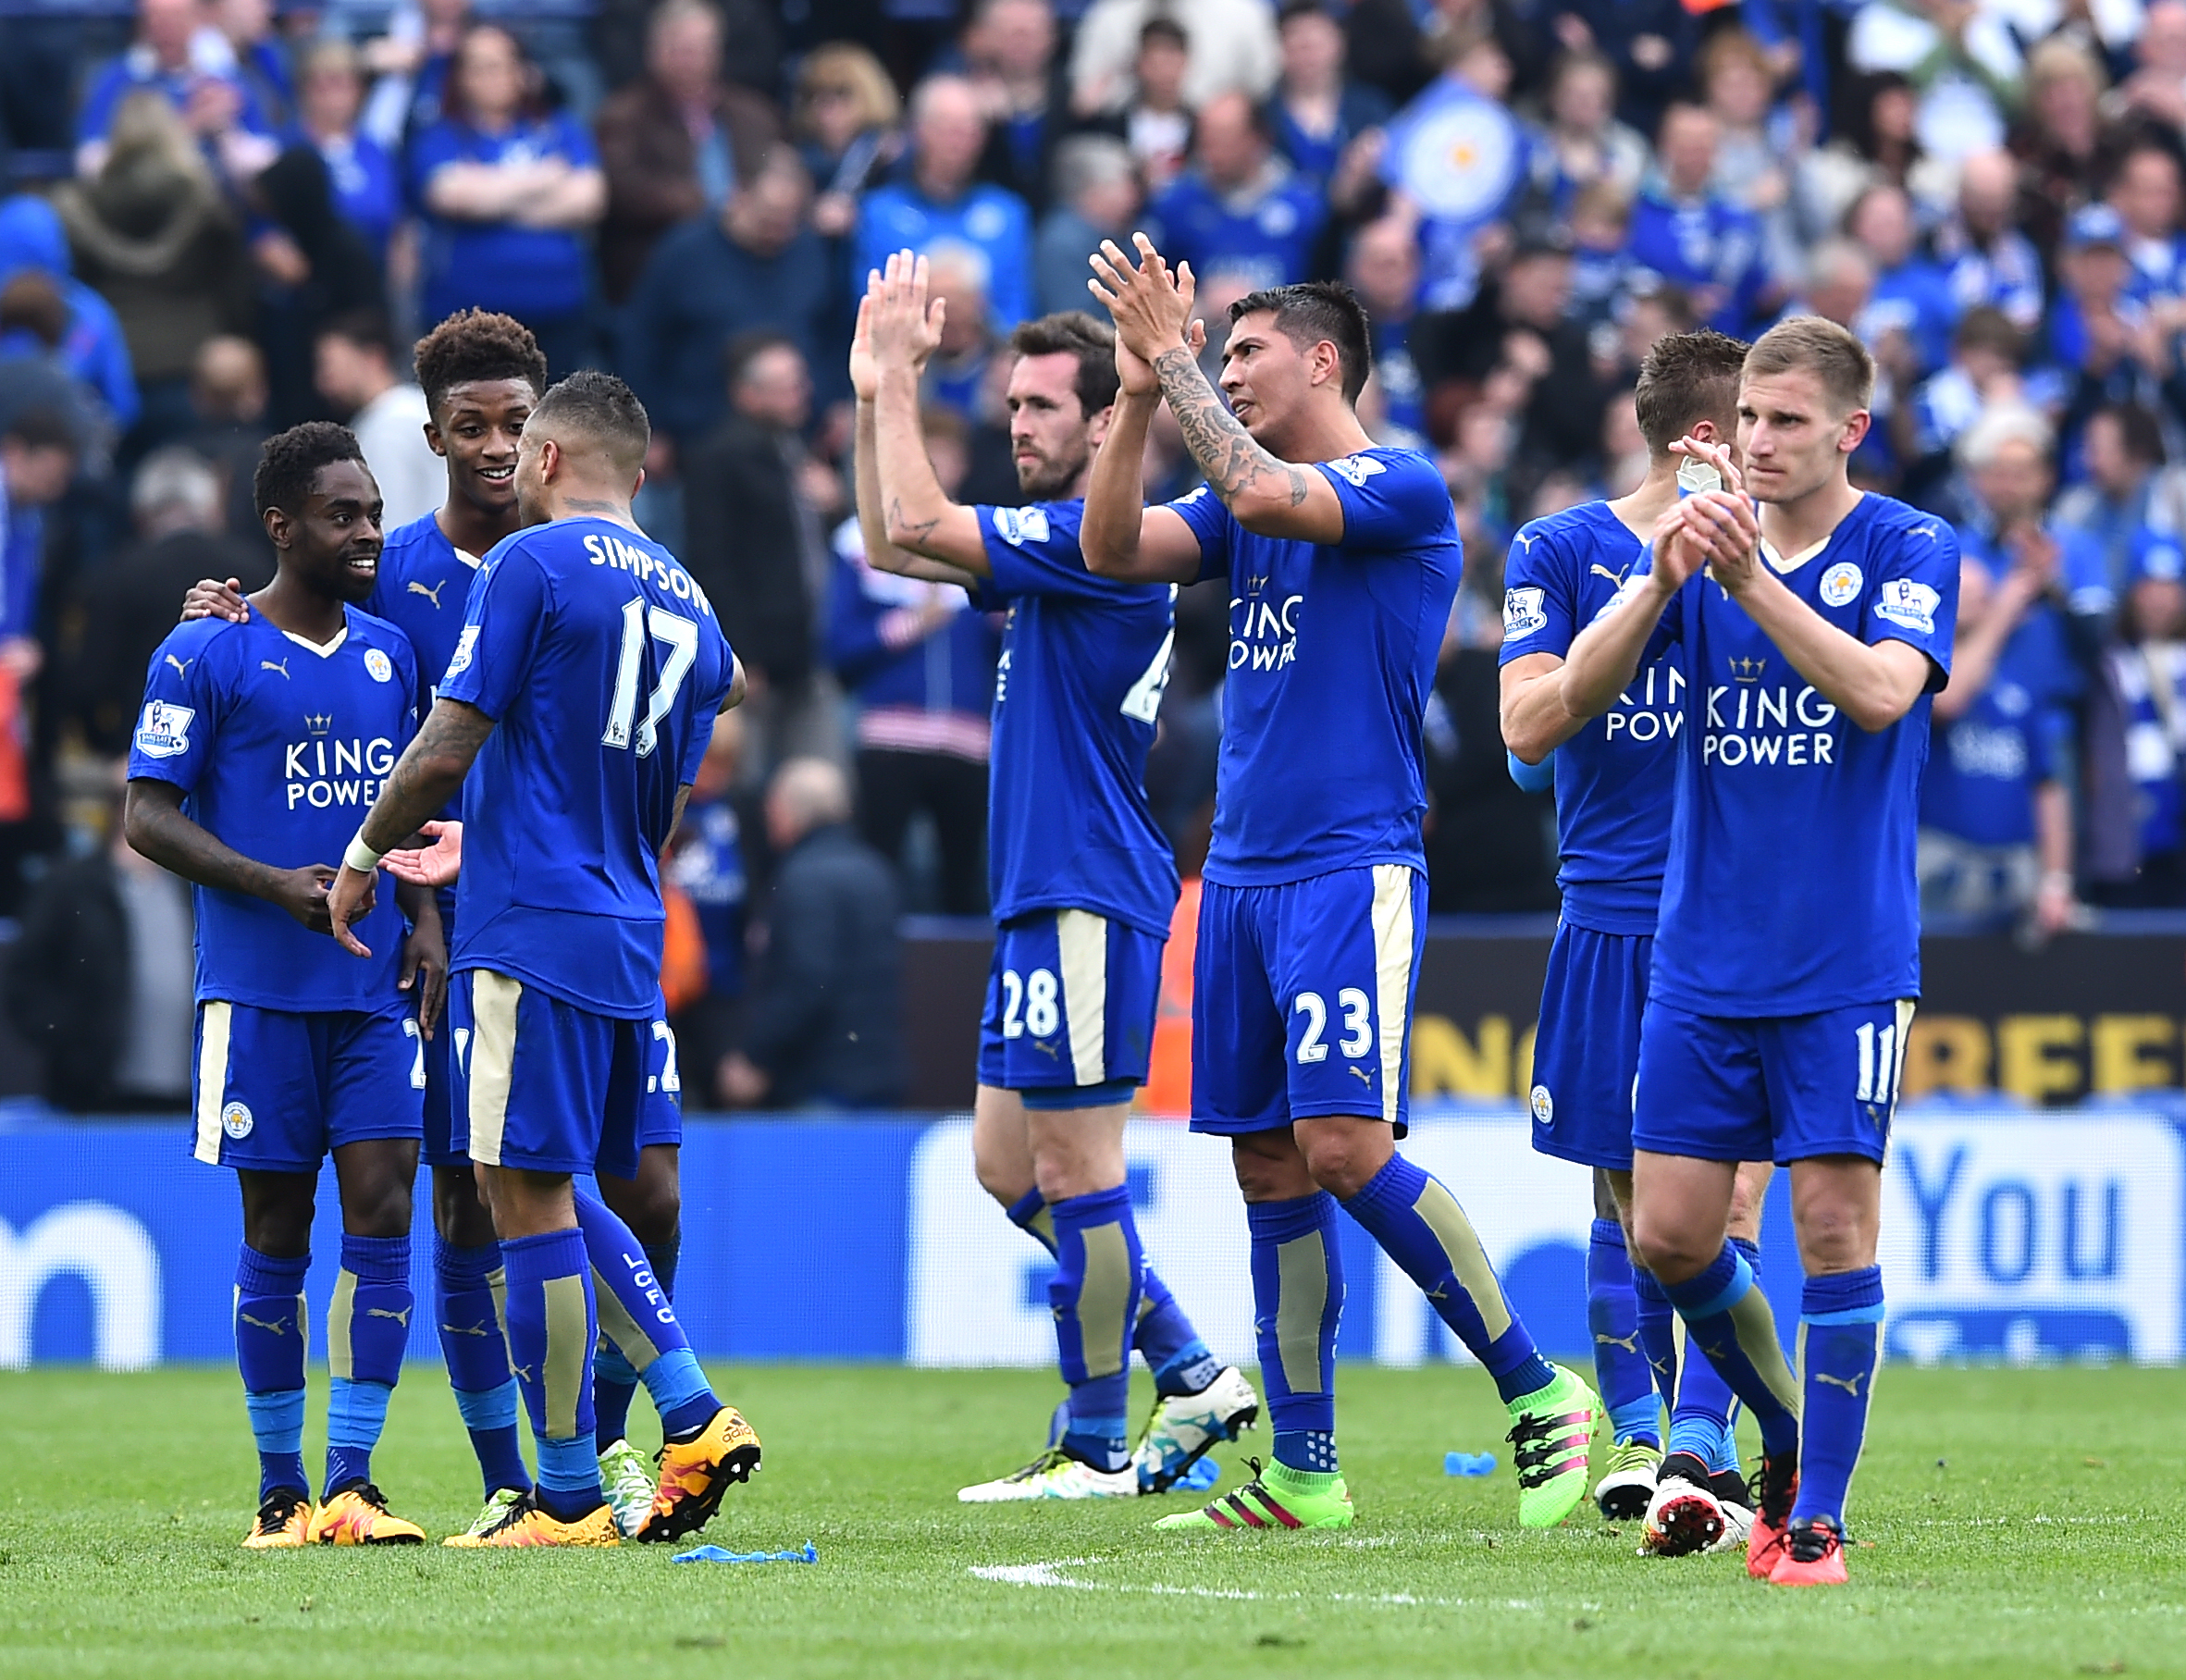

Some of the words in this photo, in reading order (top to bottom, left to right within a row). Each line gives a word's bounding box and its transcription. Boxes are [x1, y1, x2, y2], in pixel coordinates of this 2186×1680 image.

[583, 534, 710, 617] SIMPSON
[601, 595, 698, 760] 17
[1706, 686, 1837, 729] KING
[285, 736, 395, 779] KING
[1703, 733, 1834, 766] POWER
[1003, 968, 1060, 1039] 28
[1295, 987, 1373, 1065] 23
[1855, 1021, 1896, 1104] 11
[1896, 1141, 2119, 1285] You
[622, 1253, 676, 1324] LCFC
